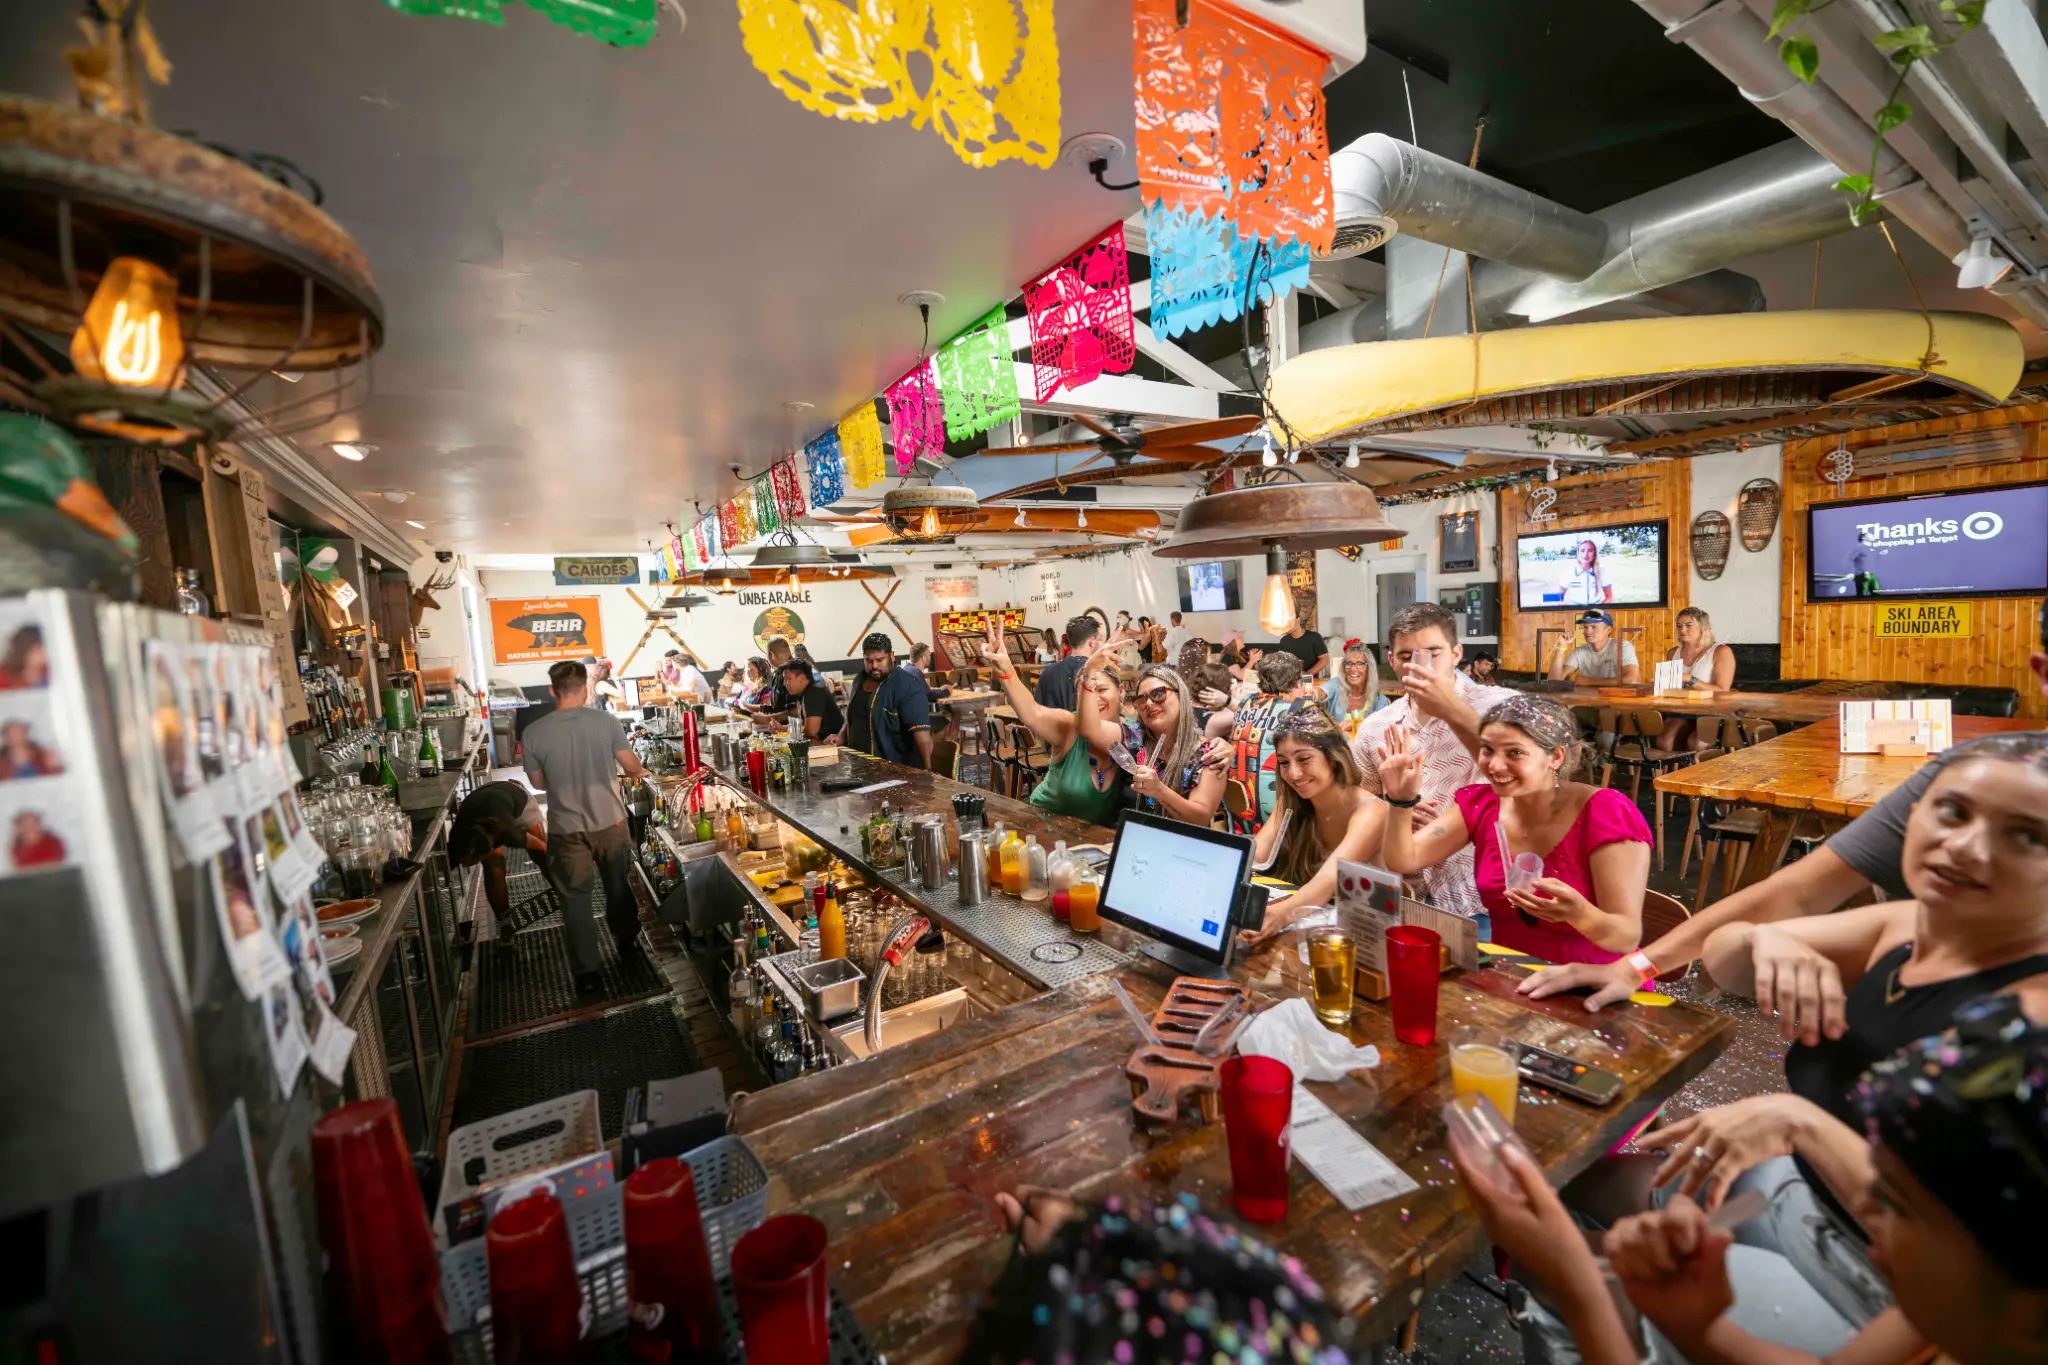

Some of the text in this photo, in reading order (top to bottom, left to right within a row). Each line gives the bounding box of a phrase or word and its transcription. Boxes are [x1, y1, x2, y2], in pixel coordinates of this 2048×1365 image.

[1825, 450, 1854, 482] 3
[1531, 486, 1557, 523] 2
[1856, 518, 1959, 541] Thanks
[567, 564, 629, 577] CANOES
[738, 590, 812, 605] UNBEARABLE
[1888, 606, 1956, 620] SKI AREA
[532, 619, 582, 633] BEHR
[1884, 620, 1960, 634] BOUNDARY
[507, 652, 540, 660] NATURAL
